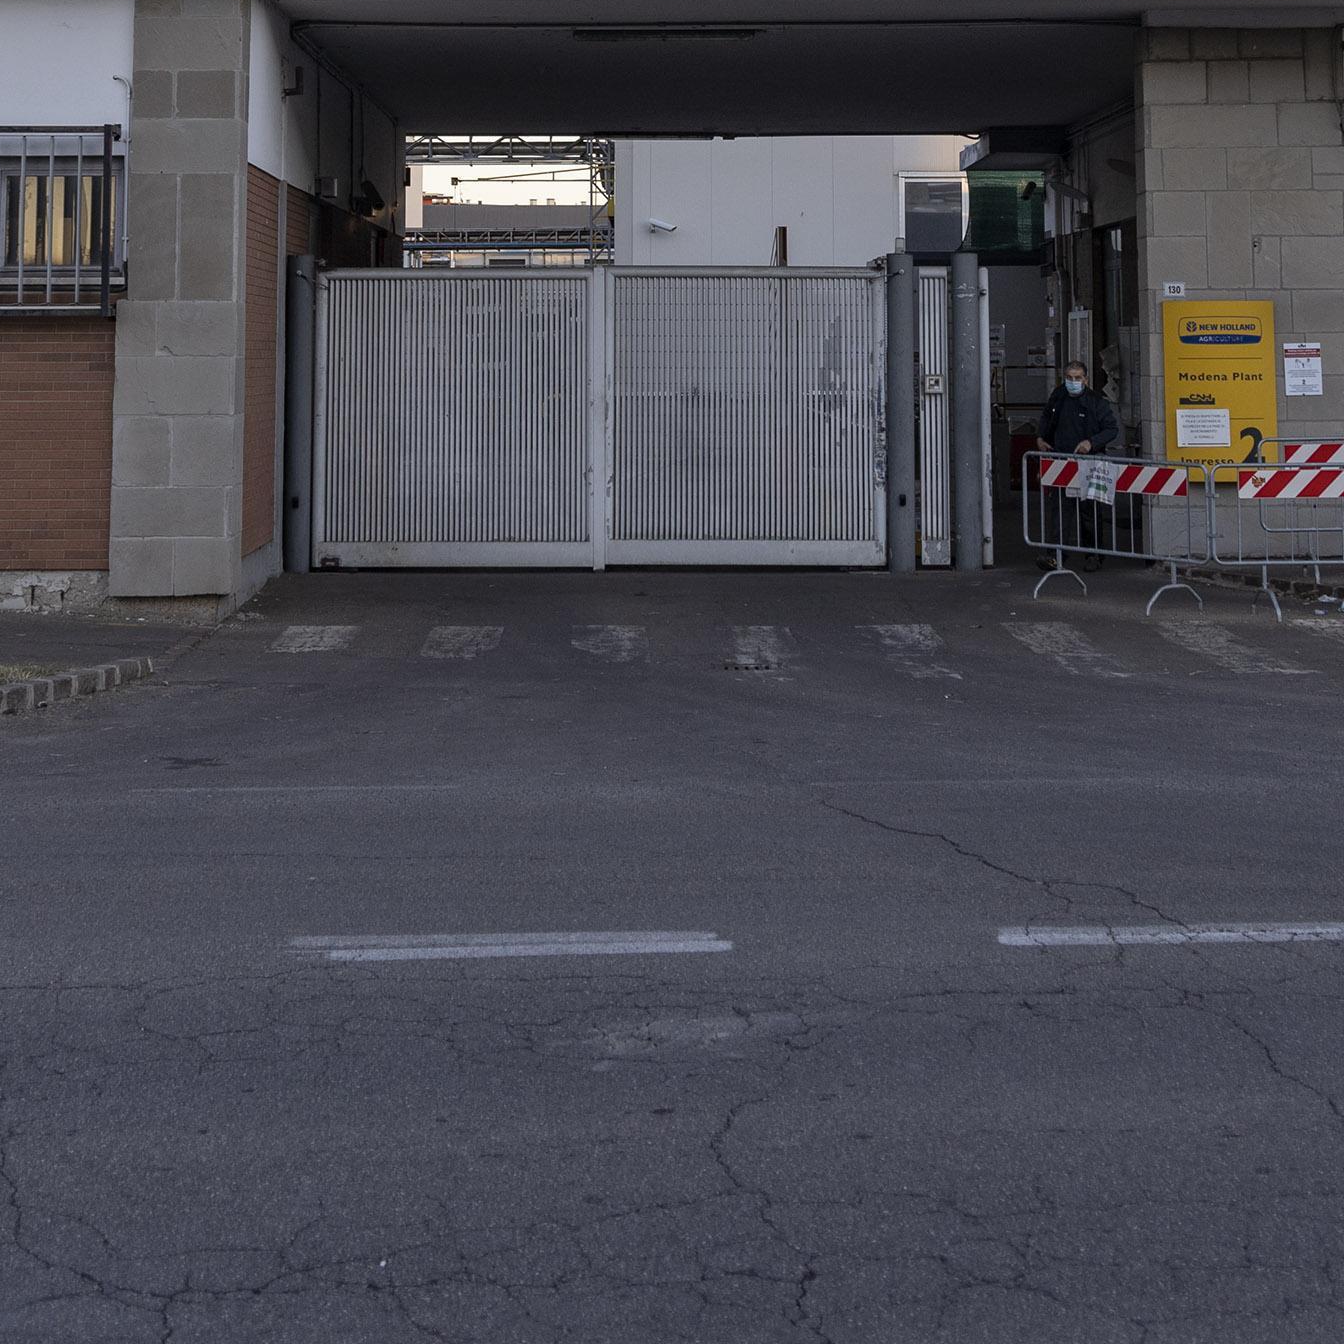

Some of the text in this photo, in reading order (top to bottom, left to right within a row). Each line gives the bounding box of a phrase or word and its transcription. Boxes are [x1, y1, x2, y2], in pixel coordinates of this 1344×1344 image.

[1168, 285, 1181, 294] 130
[1199, 323, 1256, 331] NEW HOLLAND
[1178, 372, 1264, 382] Modena Plant
[1189, 393, 1213, 402] CNH
[1240, 427, 1266, 463] 2
